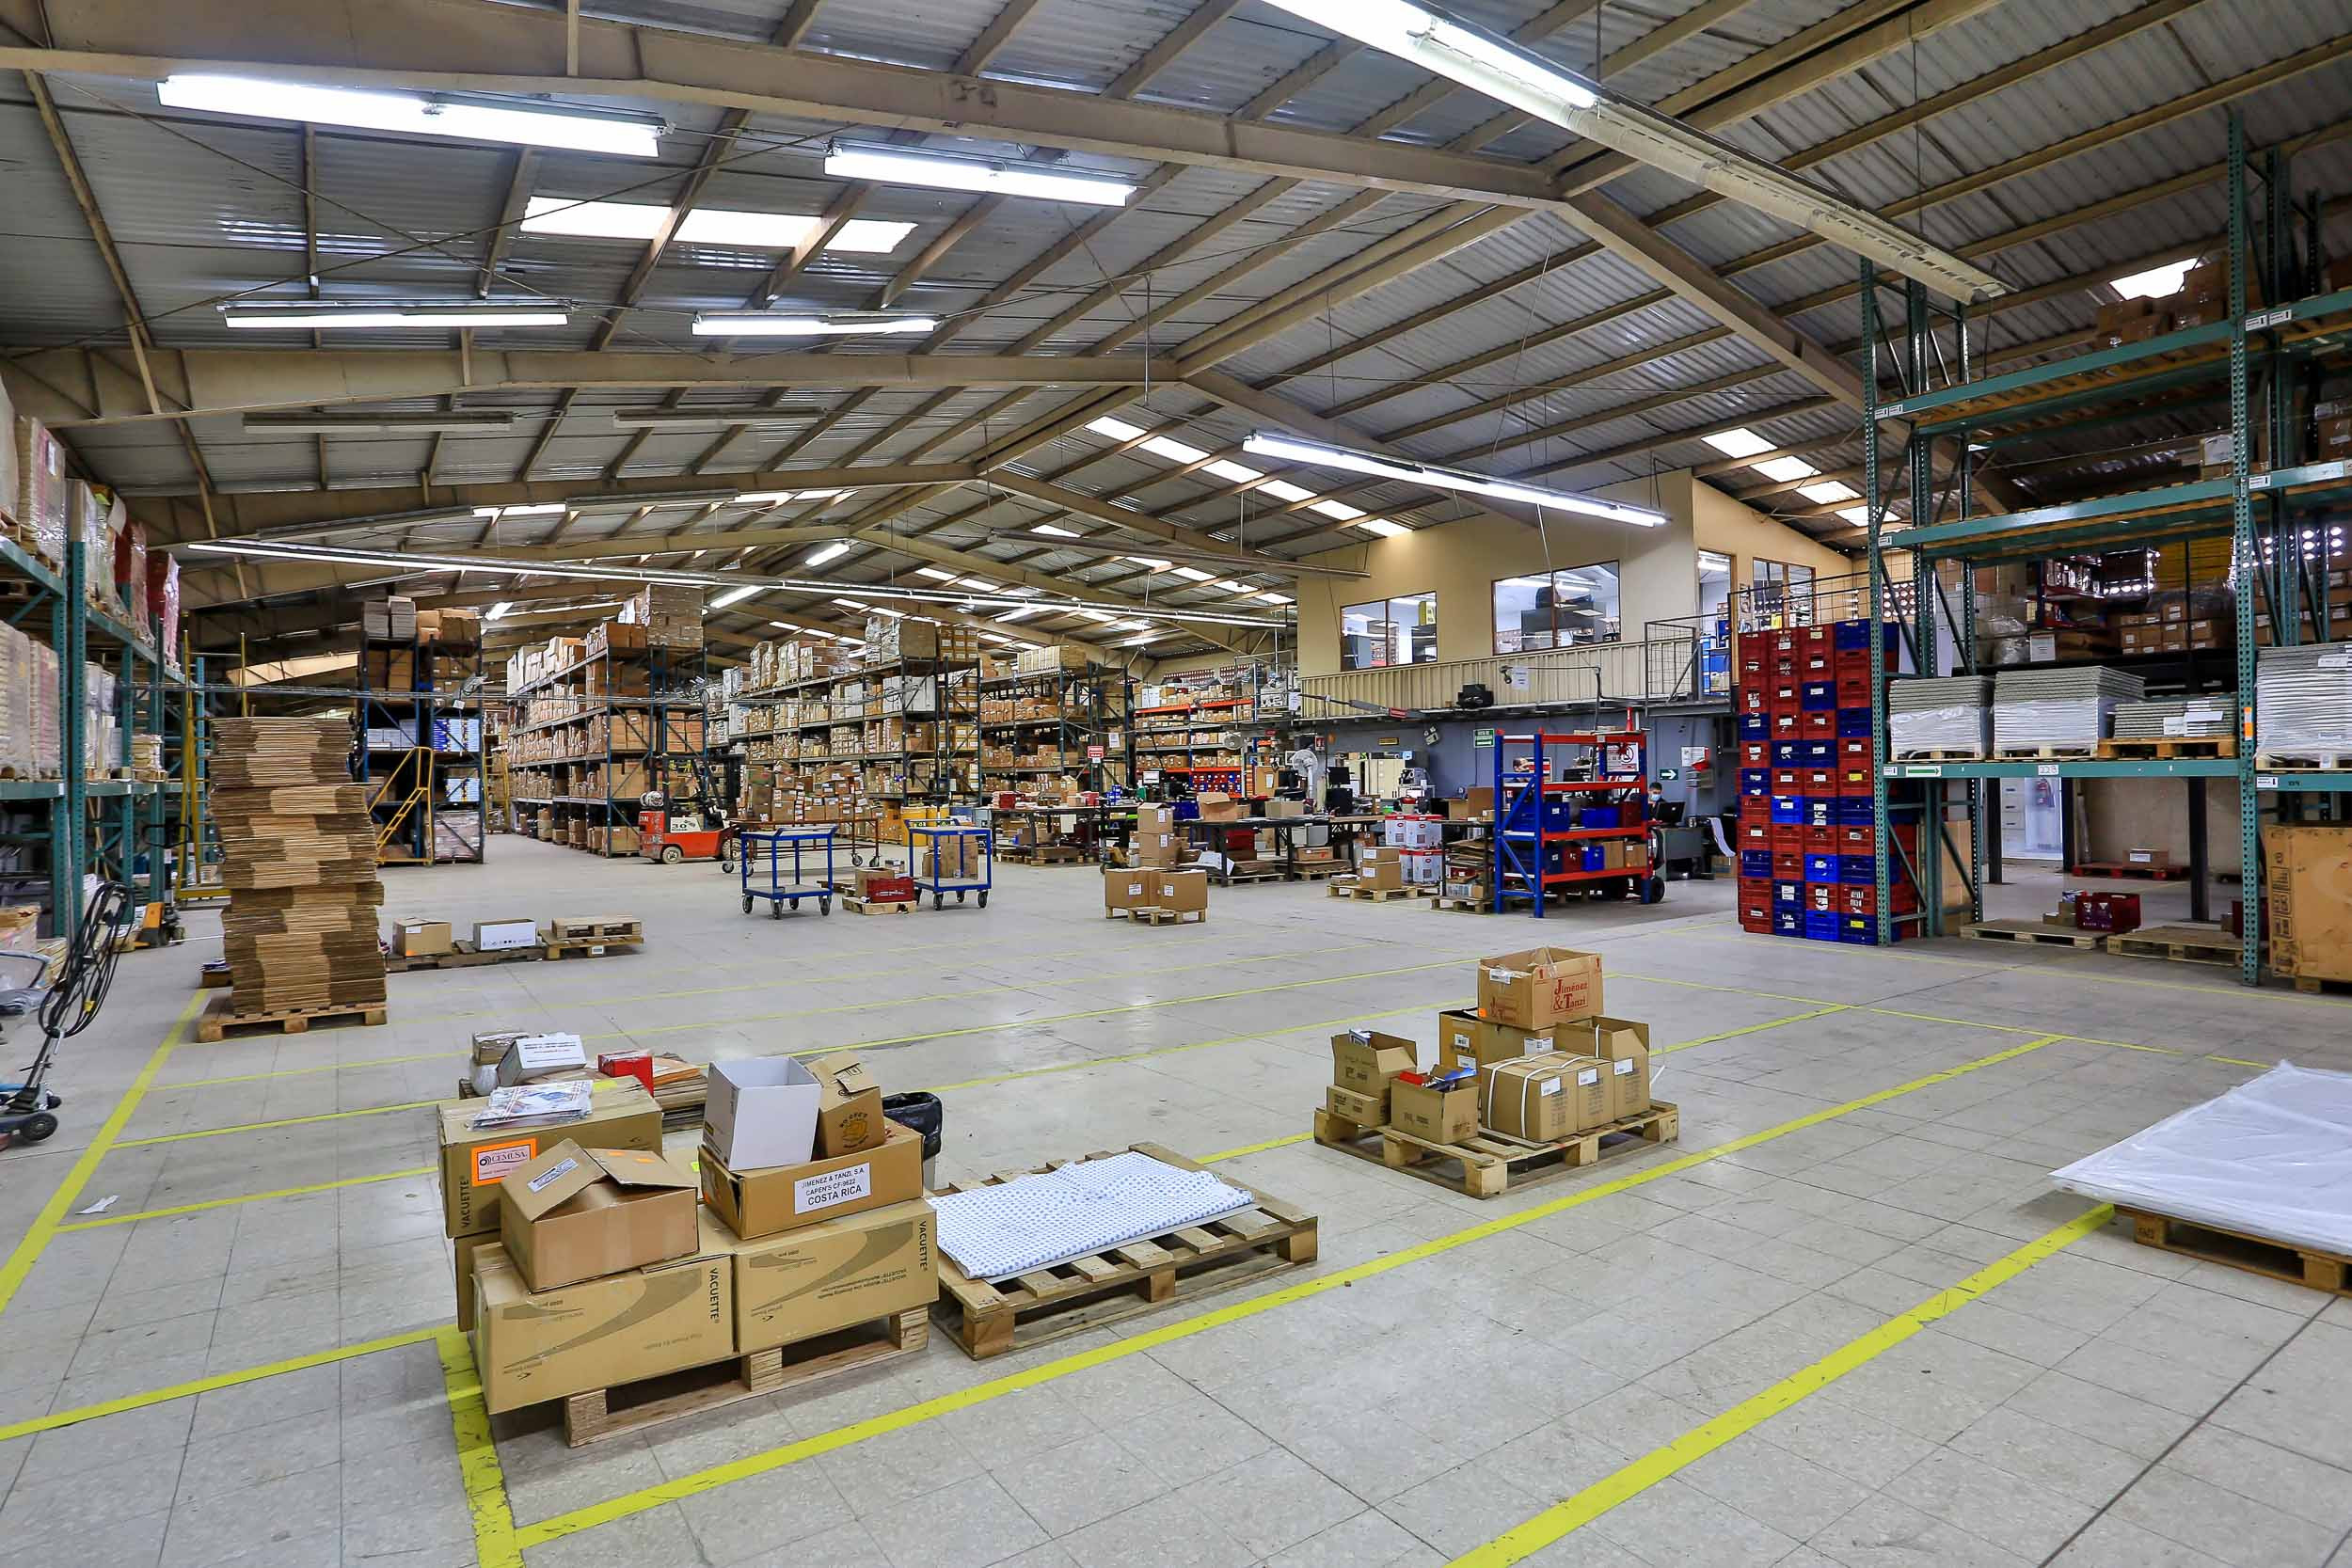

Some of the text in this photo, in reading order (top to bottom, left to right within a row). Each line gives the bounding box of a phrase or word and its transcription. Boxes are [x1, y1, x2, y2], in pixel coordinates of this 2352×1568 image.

[1564, 993, 1586, 1009] Tanzi
[802, 1177, 828, 1189] JIMENEZ
[808, 1184, 862, 1205] COSTA RICA
